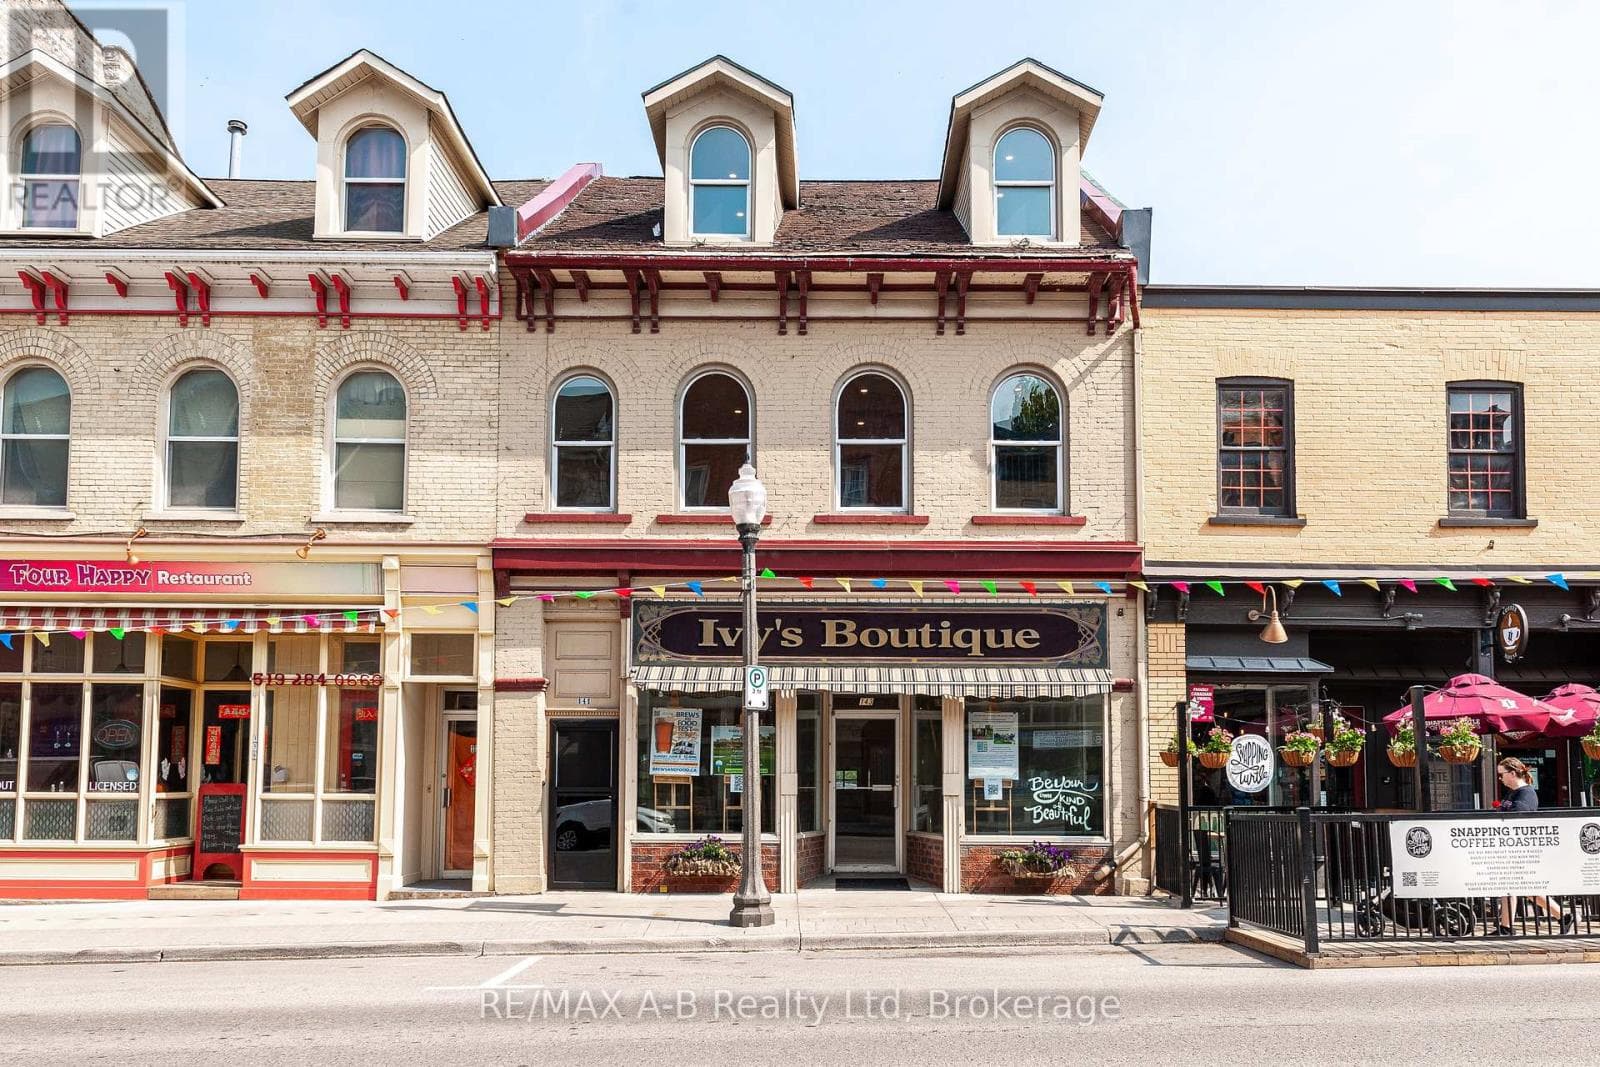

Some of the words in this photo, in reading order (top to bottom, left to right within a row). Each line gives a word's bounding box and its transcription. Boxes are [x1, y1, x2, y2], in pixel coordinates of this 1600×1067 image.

[157, 570, 252, 585] Restaurant
[821, 620, 1041, 657] Boutique
[253, 673, 286, 686] 519
[291, 673, 327, 687] 284
[335, 674, 383, 687] 0666
[1236, 741, 1268, 765] SNAPPING
[0, 780, 15, 791] UT
[89, 781, 137, 791] LICENSED
[1059, 794, 1085, 806] KIND
[1023, 805, 1092, 831] Beautiful
[1450, 827, 1510, 837] SNAPPING
[1512, 825, 1560, 836] TURTLE
[1451, 838, 1496, 849] COFFEE
[1499, 836, 1560, 847] ROASTERS
